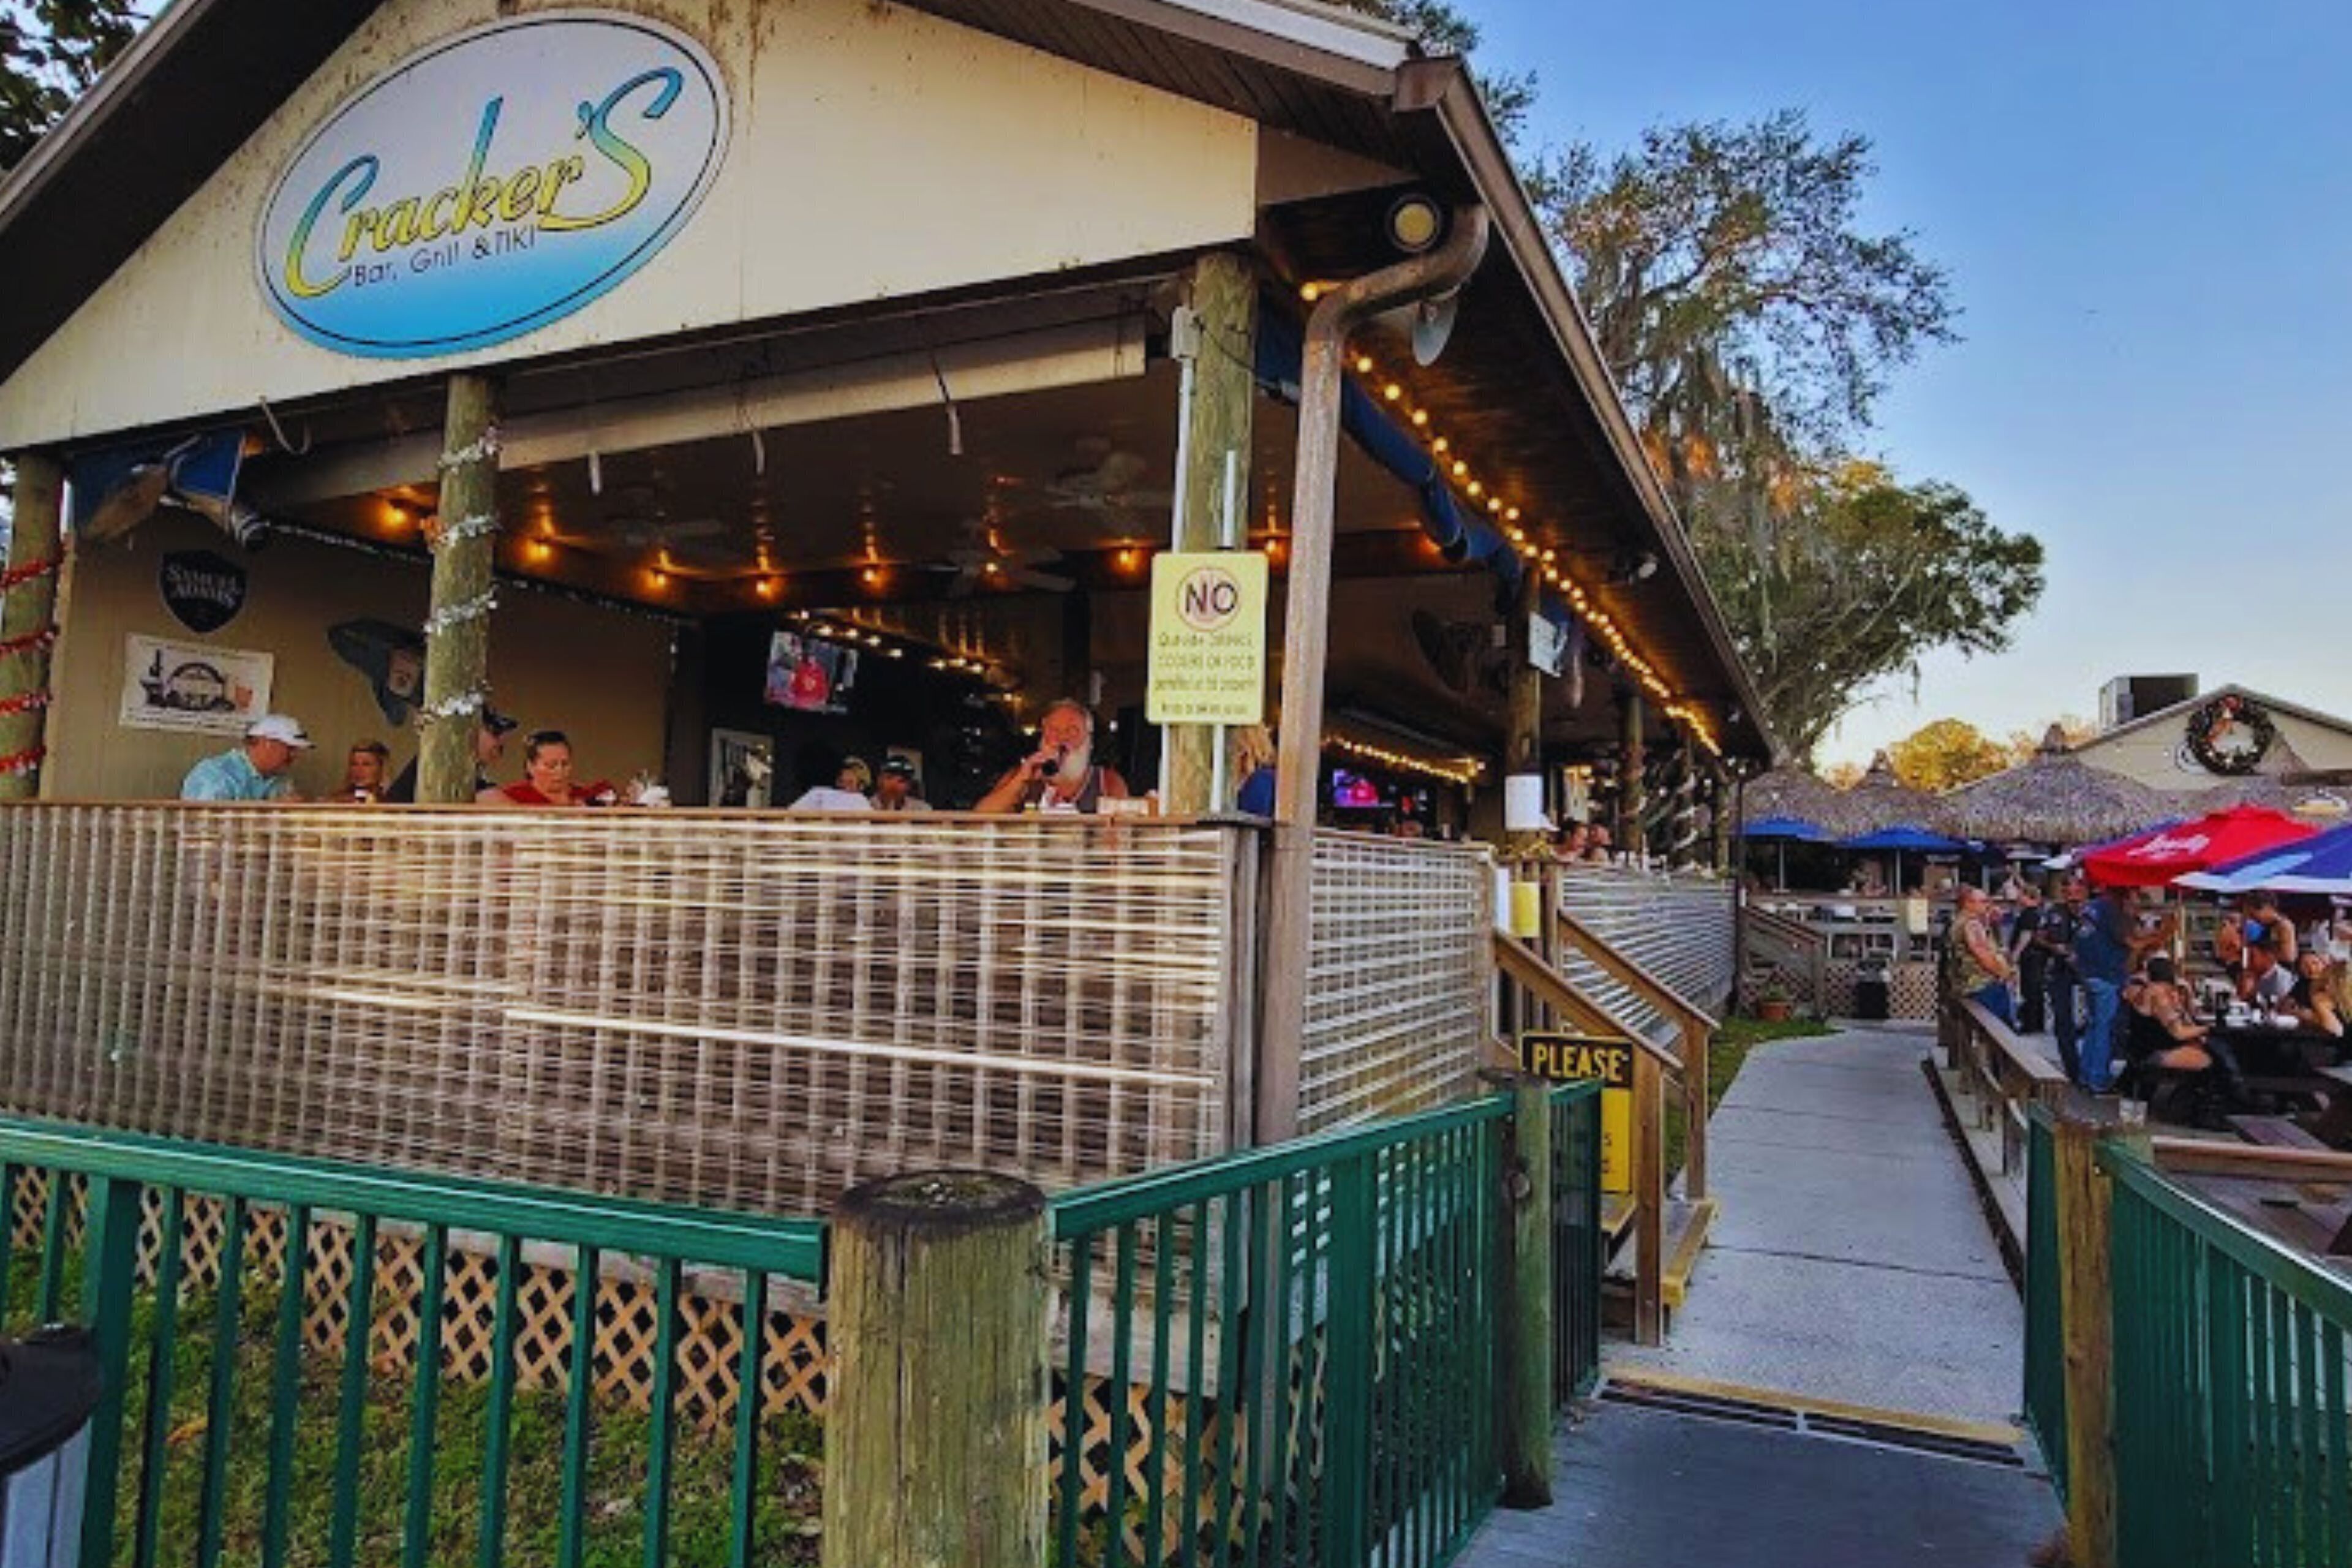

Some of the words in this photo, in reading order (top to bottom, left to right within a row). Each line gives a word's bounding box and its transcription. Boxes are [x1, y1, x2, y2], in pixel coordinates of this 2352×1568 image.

[410, 241, 459, 273] Grill
[472, 234, 492, 259] &
[1185, 582, 1238, 614] NO
[1532, 1042, 1623, 1082] PLEASE
